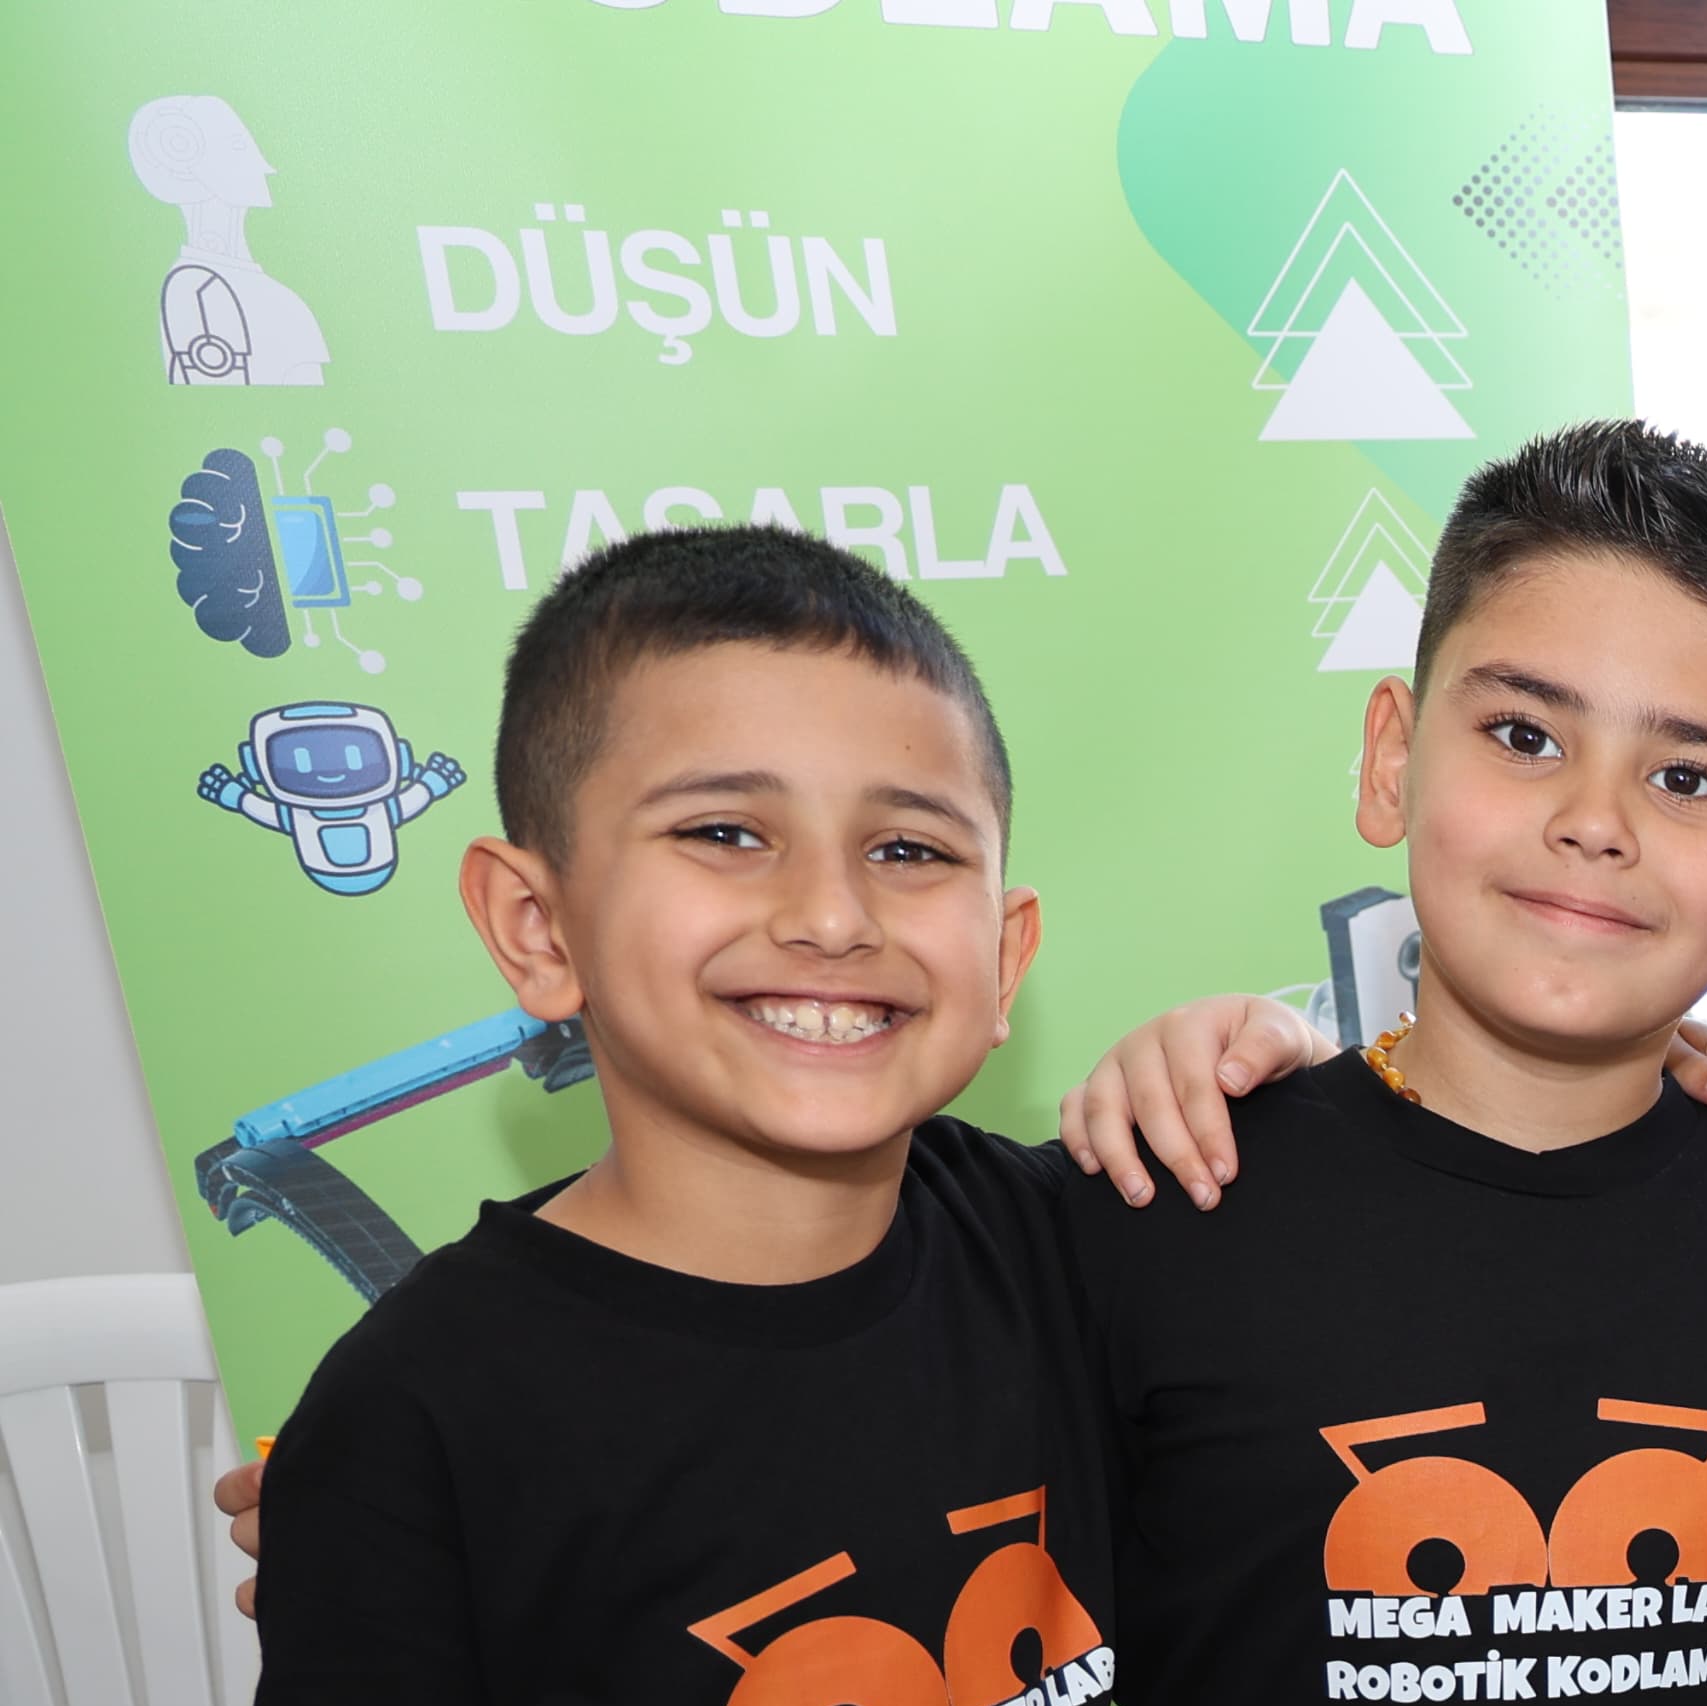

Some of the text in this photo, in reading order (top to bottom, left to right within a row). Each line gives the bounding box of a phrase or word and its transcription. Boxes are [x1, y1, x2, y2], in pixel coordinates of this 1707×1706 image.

[416, 203, 898, 366] DÜŞÜN
[1328, 1595, 1472, 1639] MEGA
[1492, 1587, 1663, 1635] MAKER
[1326, 1649, 1537, 1703] ROBOTİK
